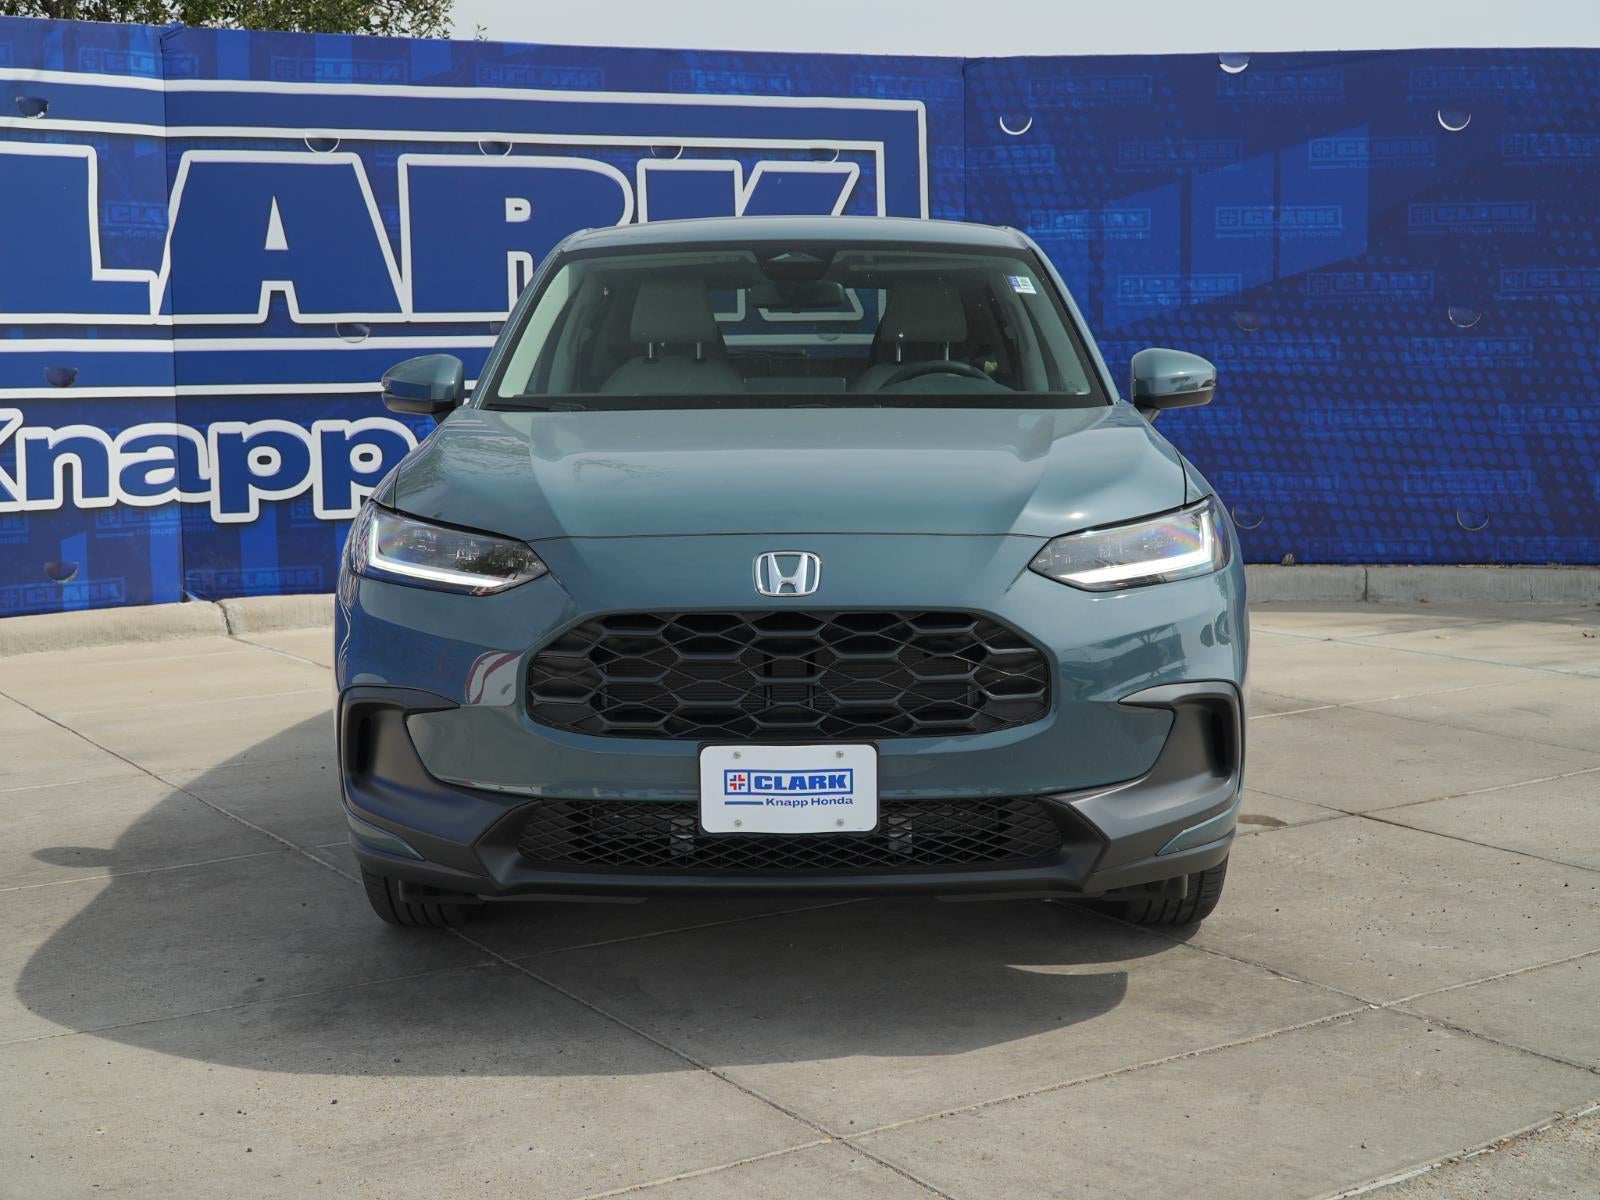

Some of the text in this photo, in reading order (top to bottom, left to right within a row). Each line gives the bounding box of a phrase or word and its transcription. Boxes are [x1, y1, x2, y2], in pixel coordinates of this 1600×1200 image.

[1243, 210, 1336, 225] CLARK
[754, 774, 848, 792] CLARK
[765, 796, 854, 809] Knapp Honda
